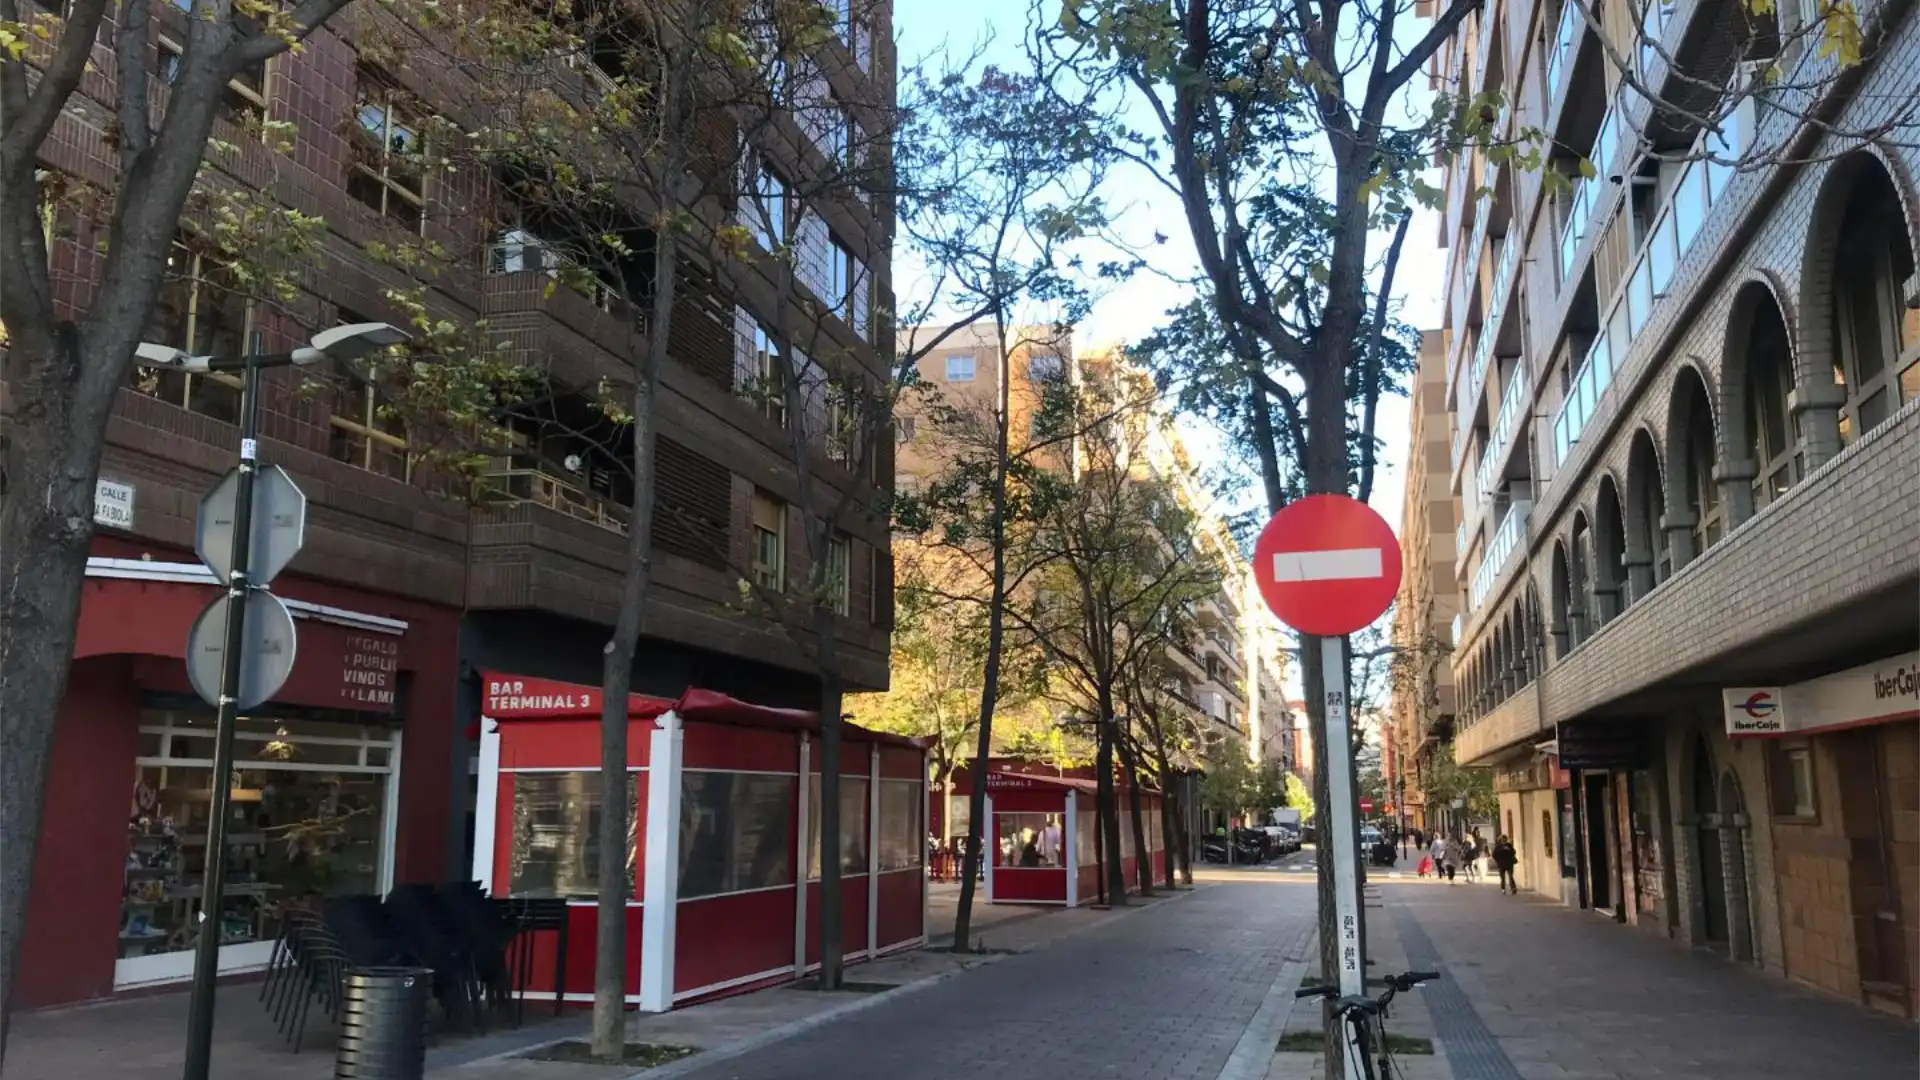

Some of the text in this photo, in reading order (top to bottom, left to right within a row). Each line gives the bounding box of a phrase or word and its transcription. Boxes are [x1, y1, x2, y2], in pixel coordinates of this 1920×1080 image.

[101, 486, 127, 502] CALLE
[343, 669, 385, 687] VINOS
[490, 681, 524, 695] BAR
[490, 694, 590, 710] TERMINAL 3
